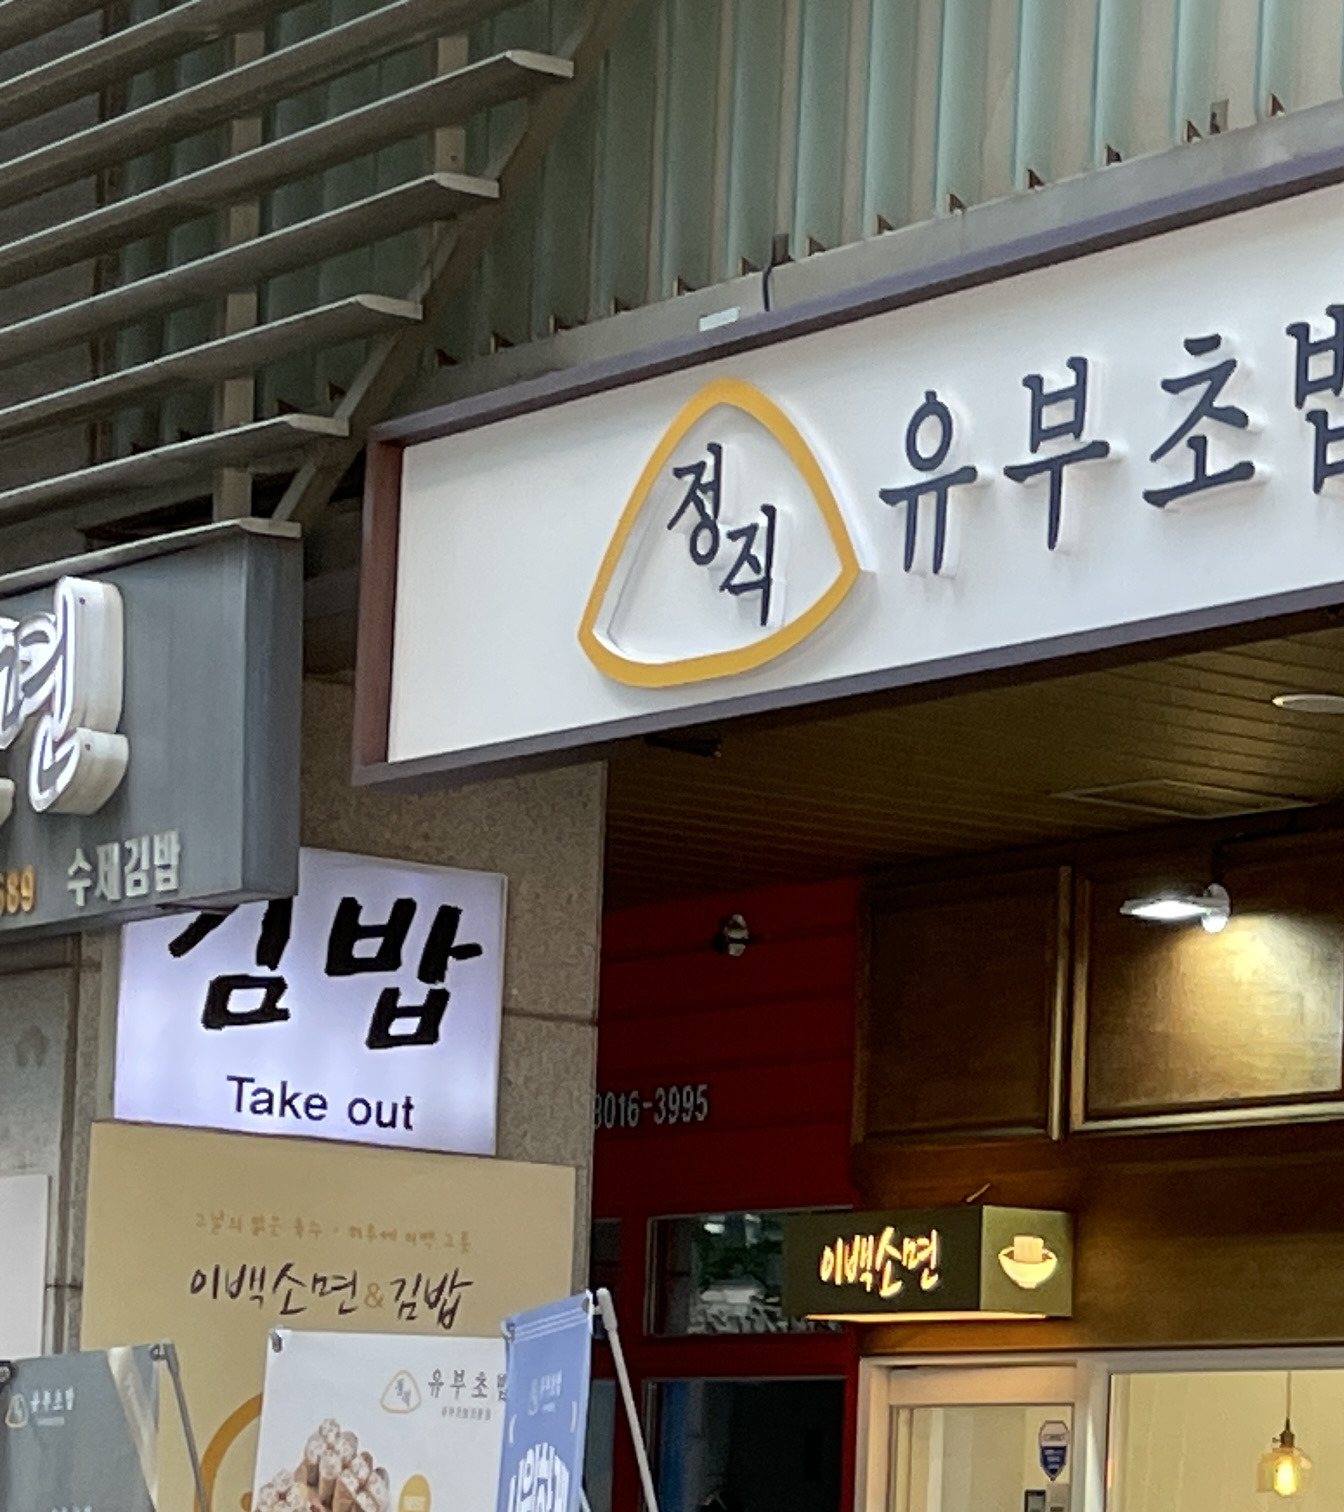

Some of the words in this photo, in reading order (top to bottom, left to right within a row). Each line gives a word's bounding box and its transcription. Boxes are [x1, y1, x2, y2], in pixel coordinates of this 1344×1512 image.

[670, 442, 777, 628] 정직
[67, 829, 181, 907] 수제김밥
[226, 1076, 329, 1122] Take
[348, 1093, 415, 1131] out
[819, 1225, 939, 1298] 이백소면
